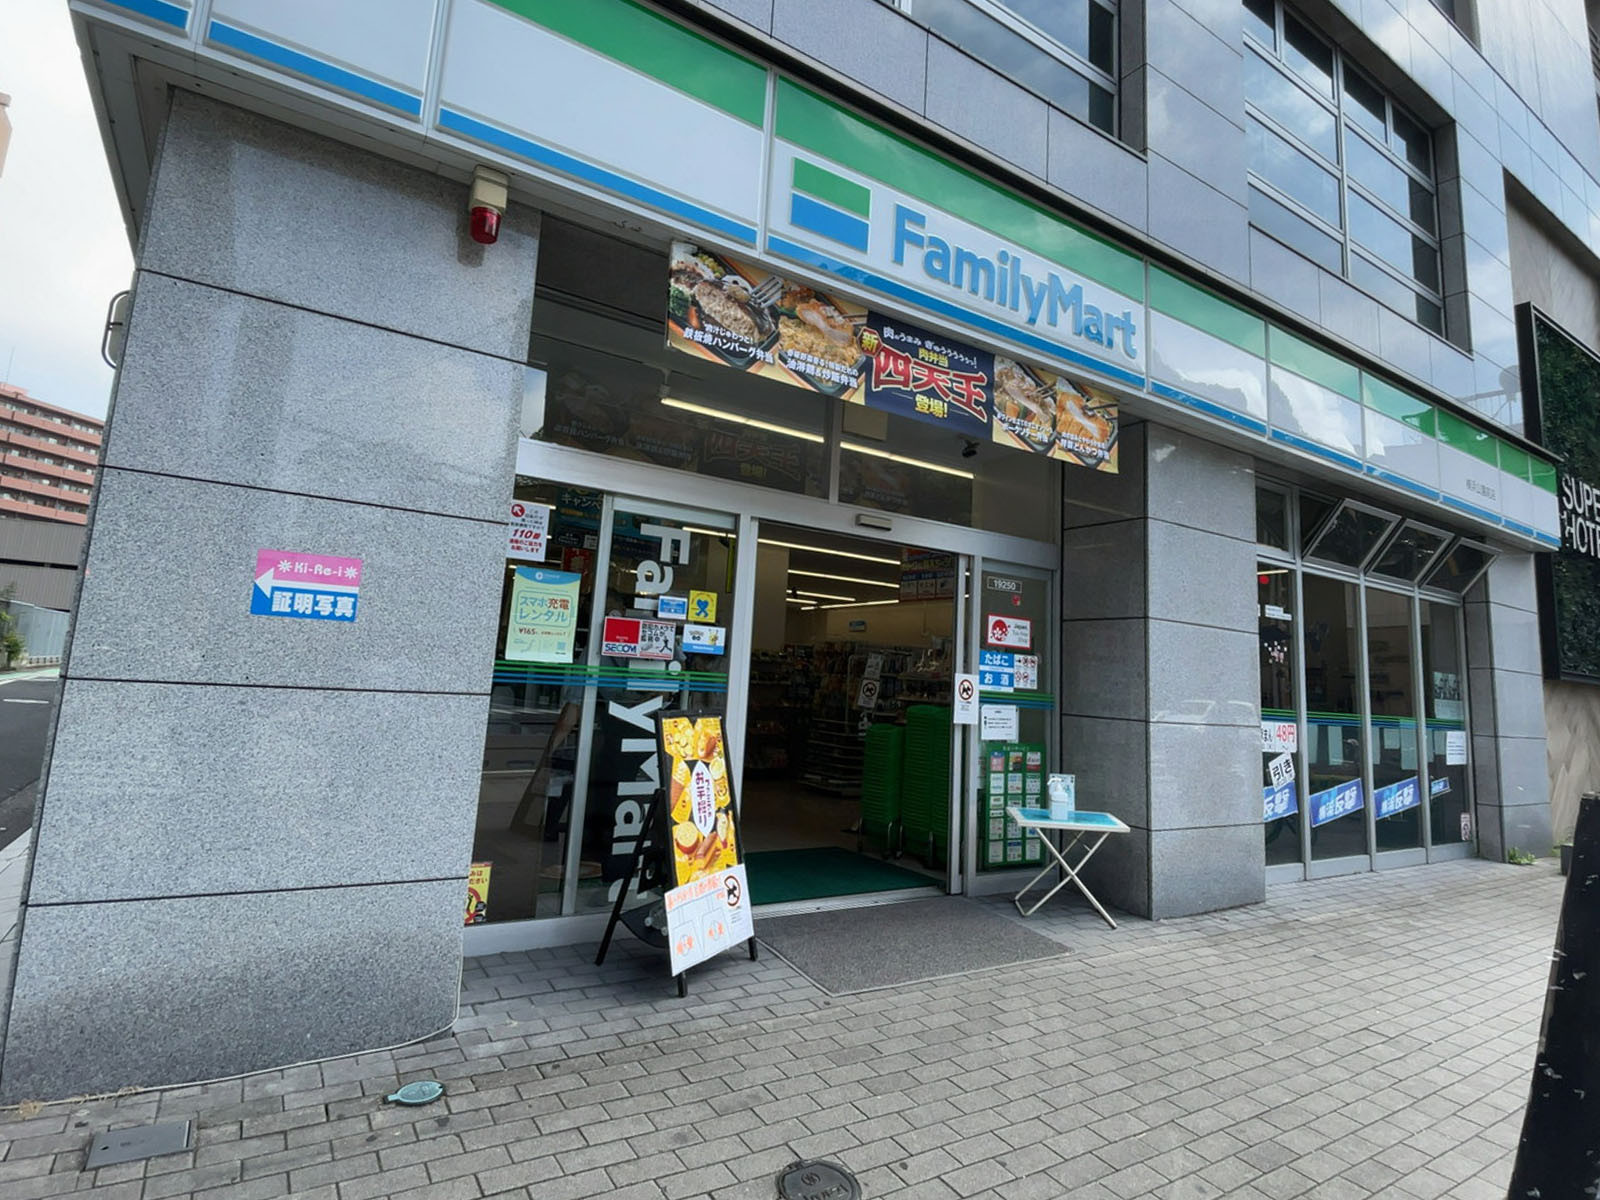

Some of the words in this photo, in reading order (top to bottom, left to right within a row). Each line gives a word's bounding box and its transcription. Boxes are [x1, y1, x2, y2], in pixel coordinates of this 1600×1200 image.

[893, 203, 1138, 359] FamilyMart
[861, 331, 878, 353] 新
[919, 348, 949, 367] 肉弁当
[872, 344, 988, 423] 四天王
[915, 393, 948, 418] 登場!
[993, 580, 1016, 590] 19250
[271, 591, 355, 618] 証明写真
[520, 596, 569, 610] スマホ充電
[519, 608, 567, 622] レンタル
[605, 642, 636, 653] SECOM
[984, 653, 1009, 666] たばこ
